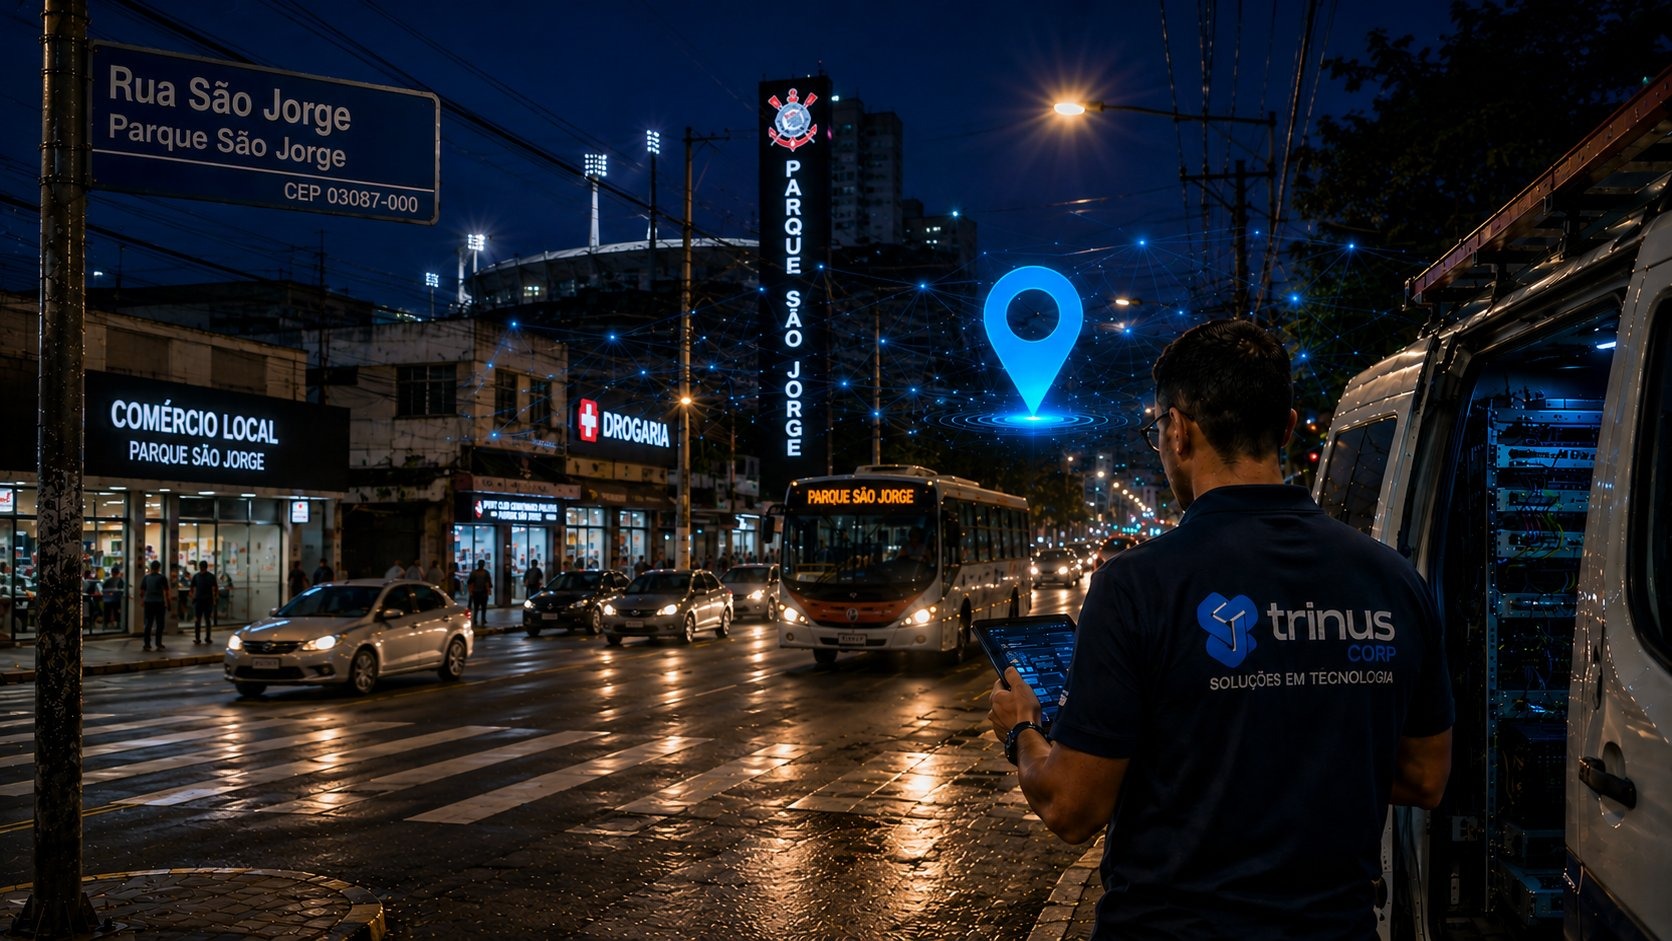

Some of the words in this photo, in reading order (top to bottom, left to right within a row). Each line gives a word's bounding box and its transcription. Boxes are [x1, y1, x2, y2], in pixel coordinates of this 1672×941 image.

[109, 65, 176, 108] Rua
[189, 77, 252, 118] São
[263, 89, 351, 136] Jorge
[109, 113, 208, 151] Parque
[217, 128, 267, 157] São
[275, 137, 346, 171] Jorge
[284, 182, 321, 202] CEP
[327, 187, 418, 213] 03087-000
[784, 159, 803, 275] PARQUE
[784, 290, 803, 348] SÃO
[111, 399, 218, 438] COMÉRCIO
[223, 414, 279, 445] LOCAL
[784, 360, 803, 457] JORGE
[603, 411, 670, 448] DROGARIA
[129, 440, 188, 465] PARQUE
[192, 443, 220, 468] SÃO
[223, 450, 265, 471] JORGE
[807, 489, 850, 506] PARQUE
[852, 486, 876, 505] SÃO
[878, 488, 914, 504] JORGE
[1266, 601, 1396, 642] trinus
[1347, 644, 1397, 662] CORP
[1209, 670, 1281, 691] SOLUÇÕES
[1285, 672, 1305, 686] EM
